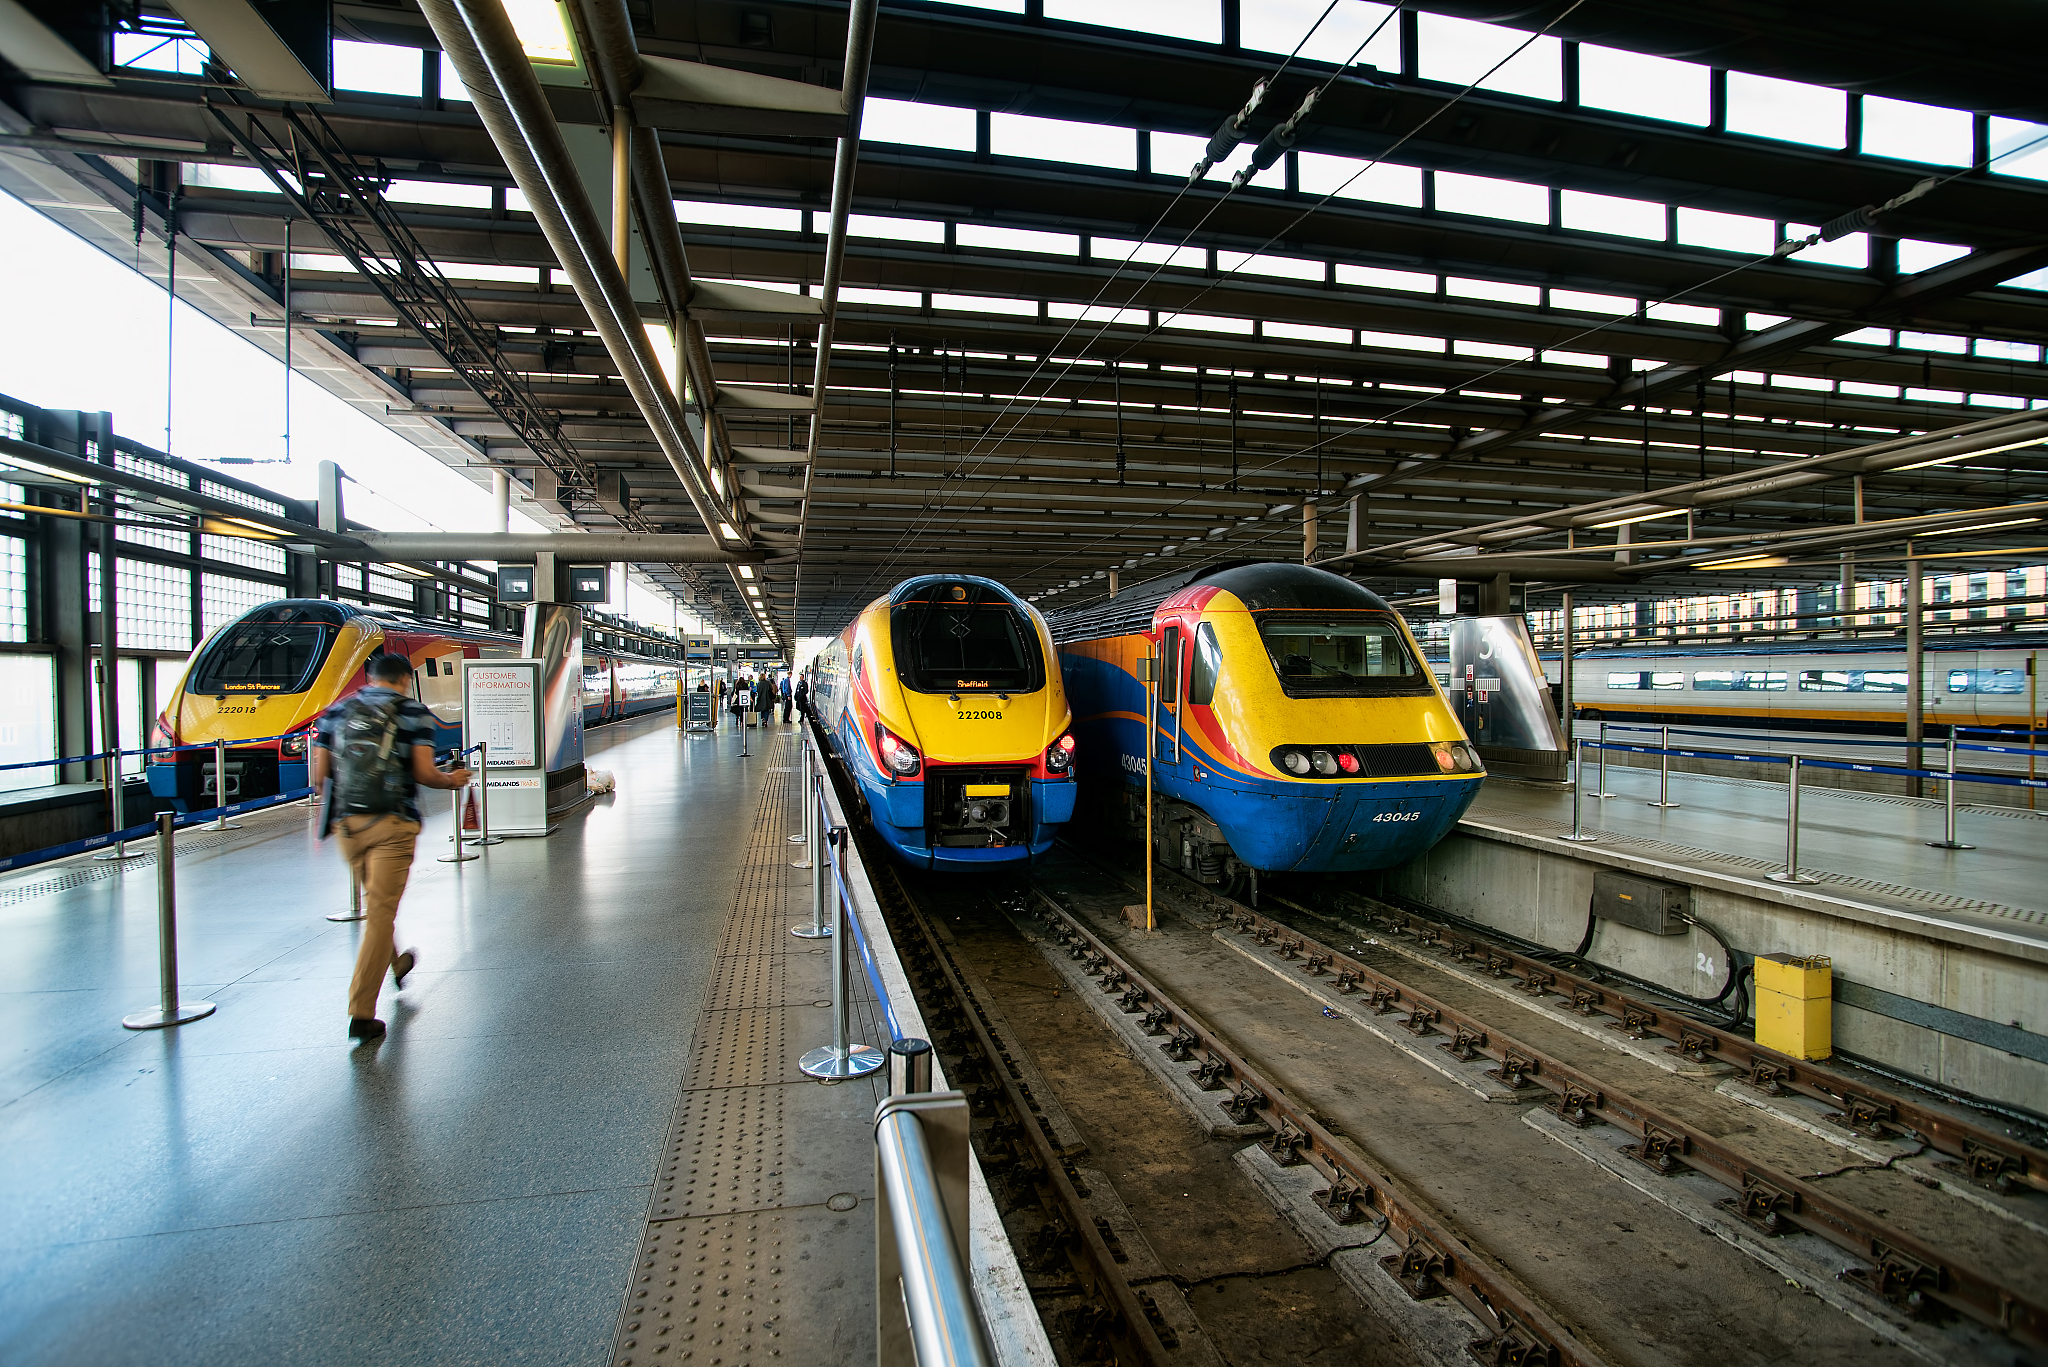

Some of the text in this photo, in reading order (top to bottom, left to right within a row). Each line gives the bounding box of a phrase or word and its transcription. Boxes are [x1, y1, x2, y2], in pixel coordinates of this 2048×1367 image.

[472, 672, 517, 680] CUSTOMER
[472, 681, 531, 689] INFORMATION
[741, 694, 749, 705] B
[217, 706, 257, 714] 222018
[957, 710, 1003, 720] 222008
[1121, 753, 1147, 776] 43045
[520, 779, 539, 787] TRAINS
[1372, 811, 1421, 823] 43045
[1696, 952, 1714, 977] 26
